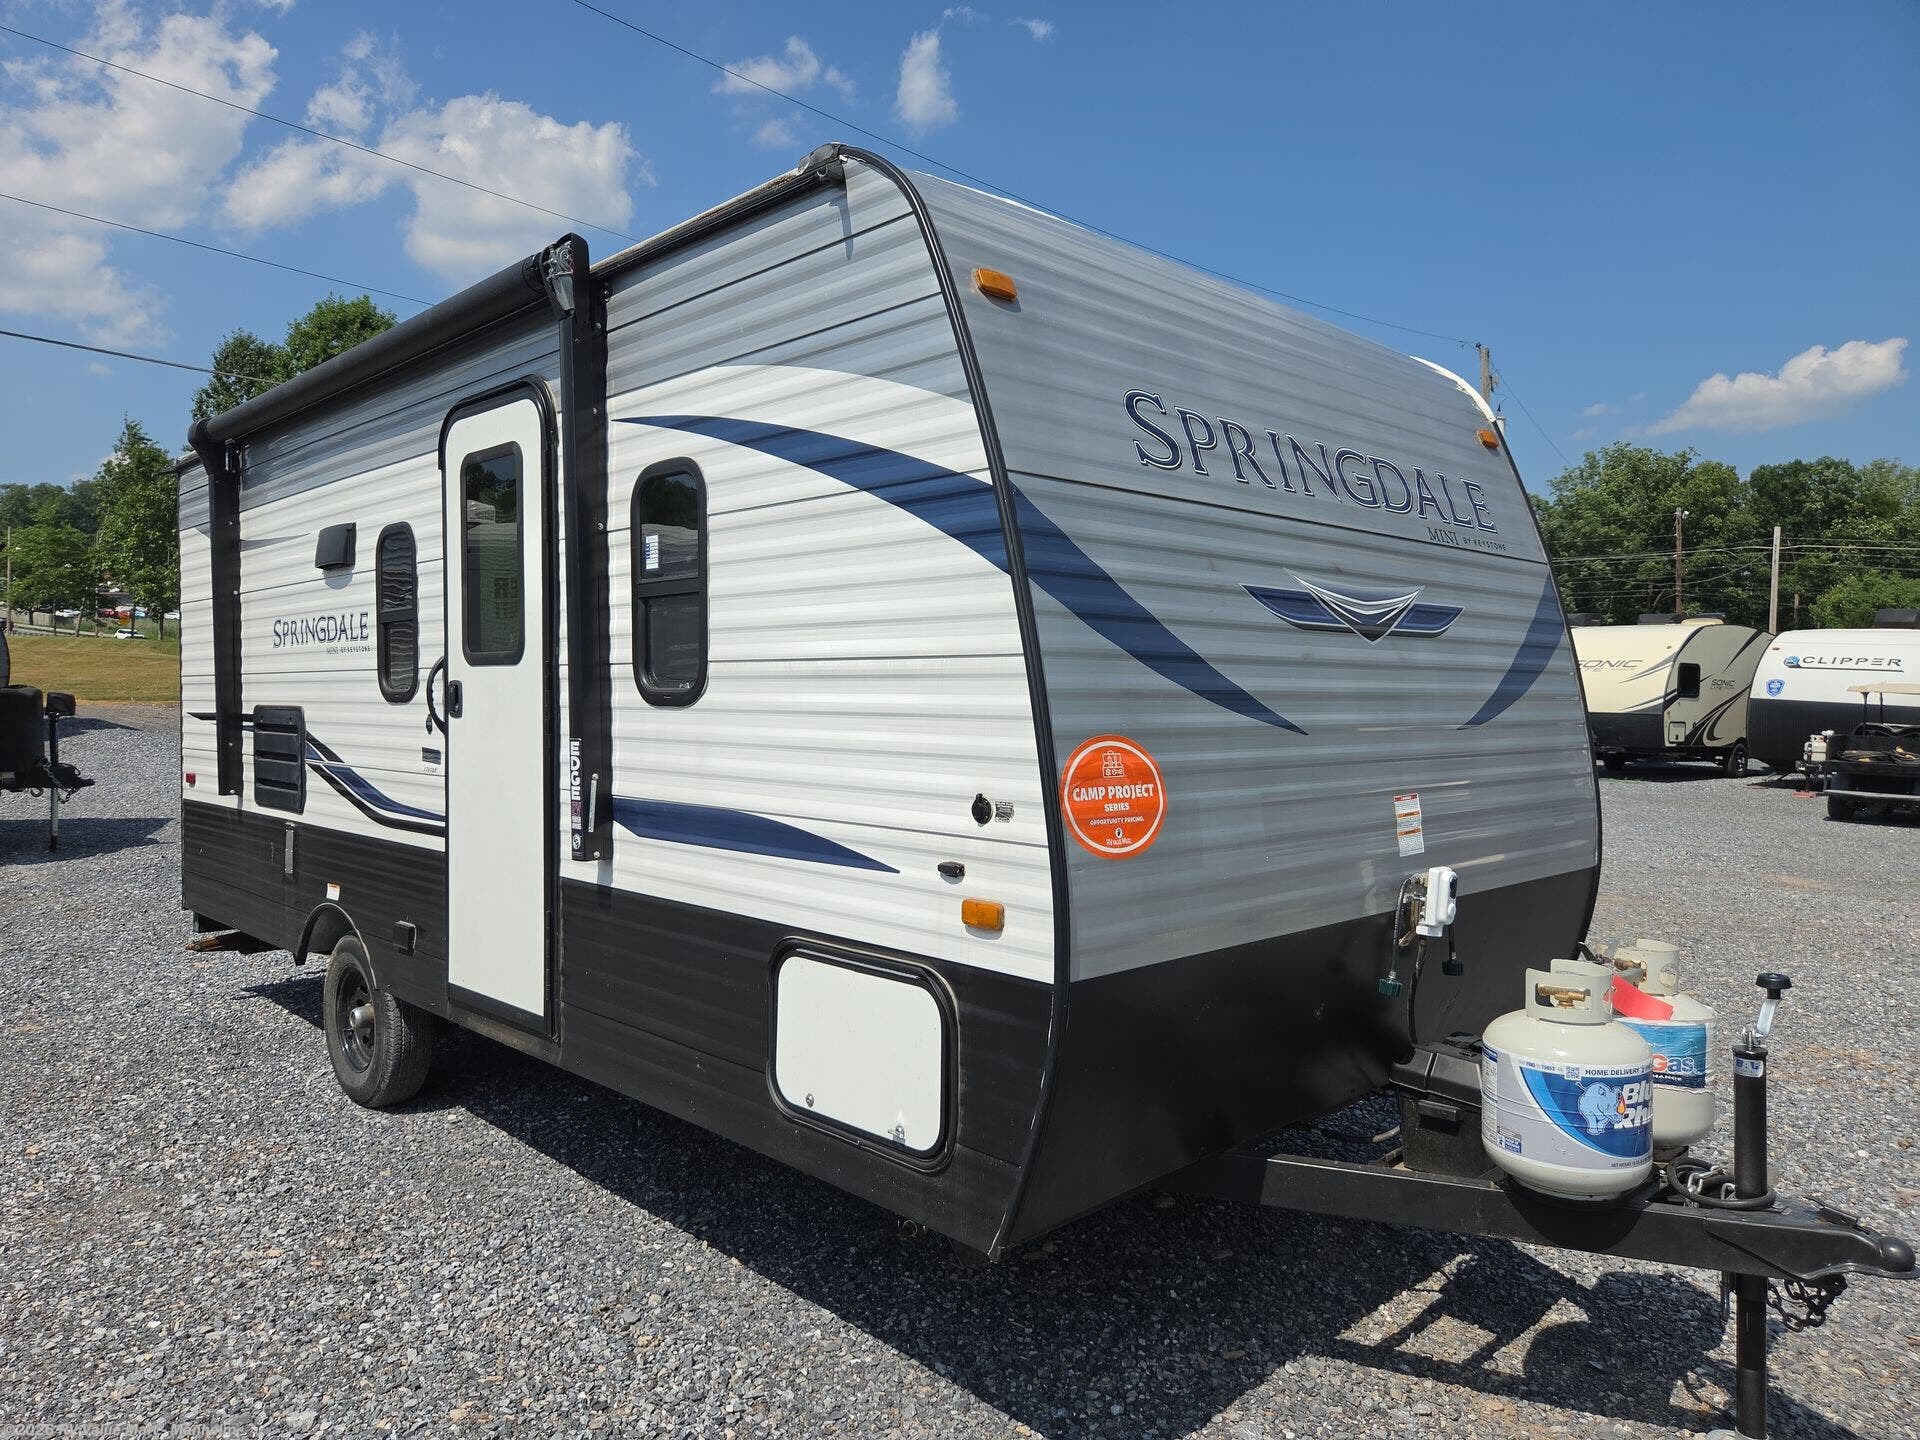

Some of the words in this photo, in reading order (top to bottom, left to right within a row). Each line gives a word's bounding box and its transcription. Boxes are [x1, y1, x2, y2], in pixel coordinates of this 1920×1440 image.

[1122, 388, 1498, 533] SPRINGDALE
[1426, 526, 1460, 546] MINI
[1462, 536, 1472, 545] BY
[1474, 538, 1507, 551] KEYSTONE
[273, 612, 368, 648] SPRINGDALE
[1802, 656, 1902, 667] CLIPPER
[1073, 786, 1105, 802] CAMP
[1108, 784, 1154, 799] PROJECT
[1104, 803, 1129, 812] SERIES
[1089, 817, 1124, 826] OPPORTUNITY
[1585, 1068, 1608, 1076] HOME
[1611, 1066, 1640, 1076] DELIVERY
[1622, 1079, 1653, 1105] Blu
